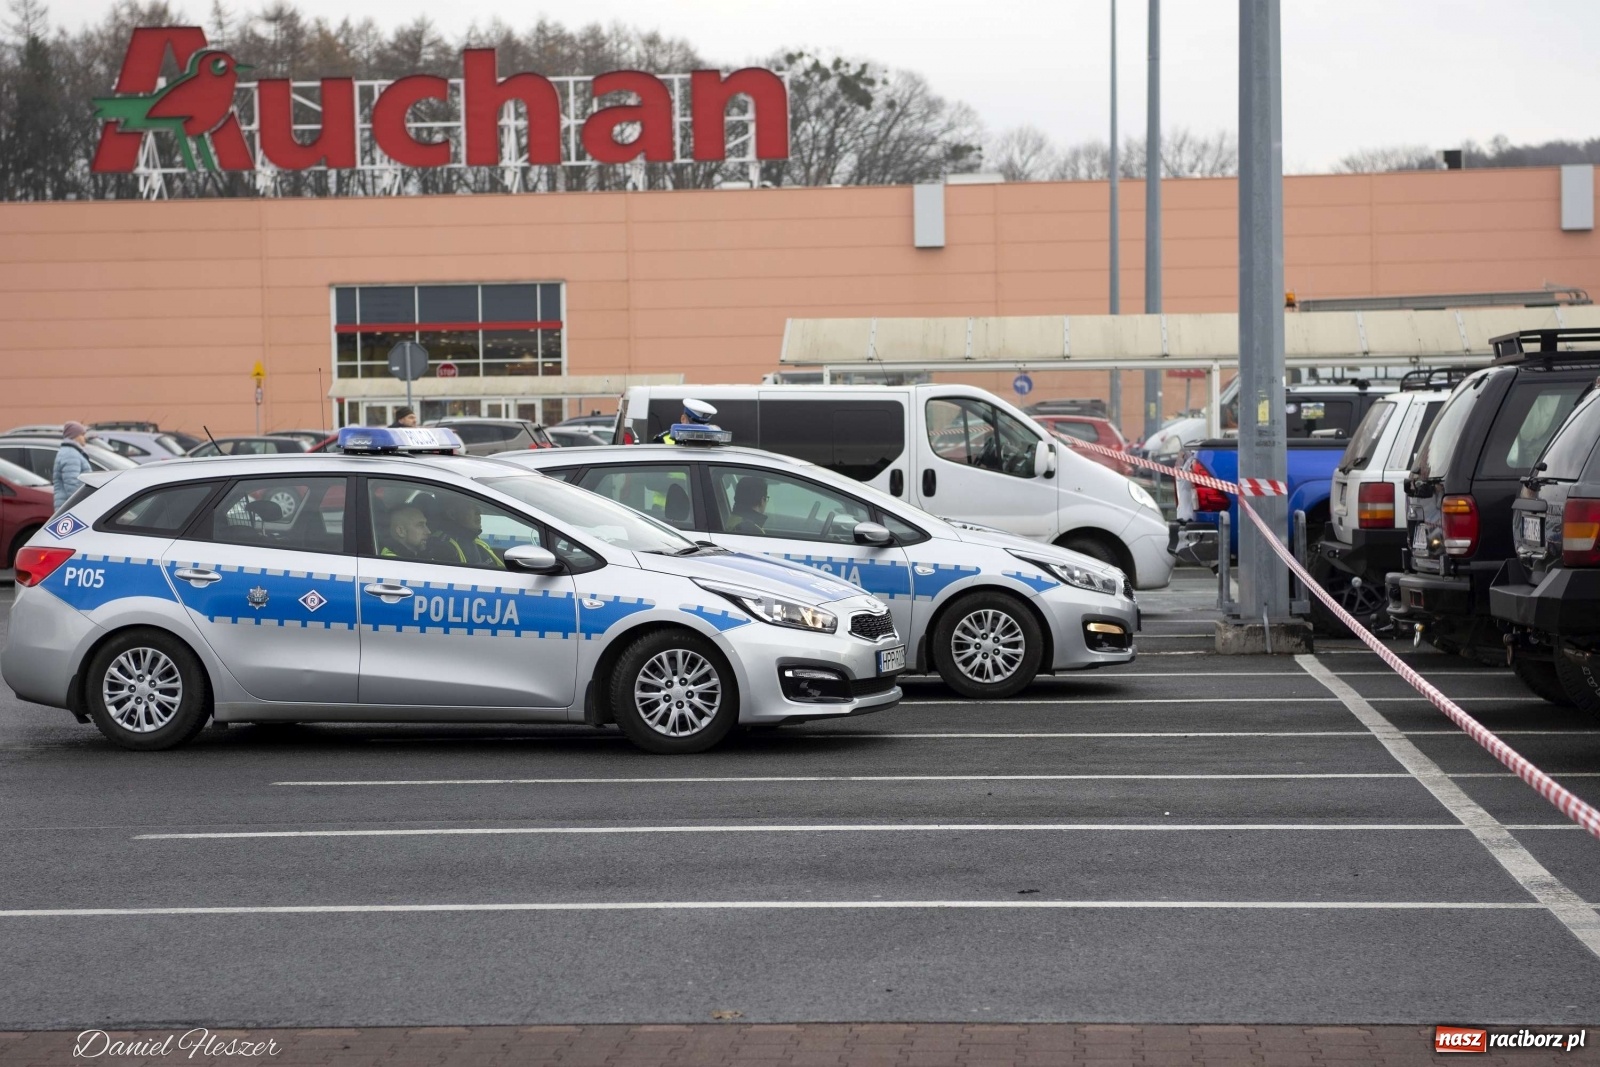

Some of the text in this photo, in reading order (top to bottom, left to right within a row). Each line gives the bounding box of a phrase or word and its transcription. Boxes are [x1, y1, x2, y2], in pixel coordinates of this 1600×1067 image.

[92, 26, 791, 173] Auchan
[440, 368, 456, 376] STOP
[64, 566, 105, 588] P105
[413, 595, 520, 626] POLICJA
